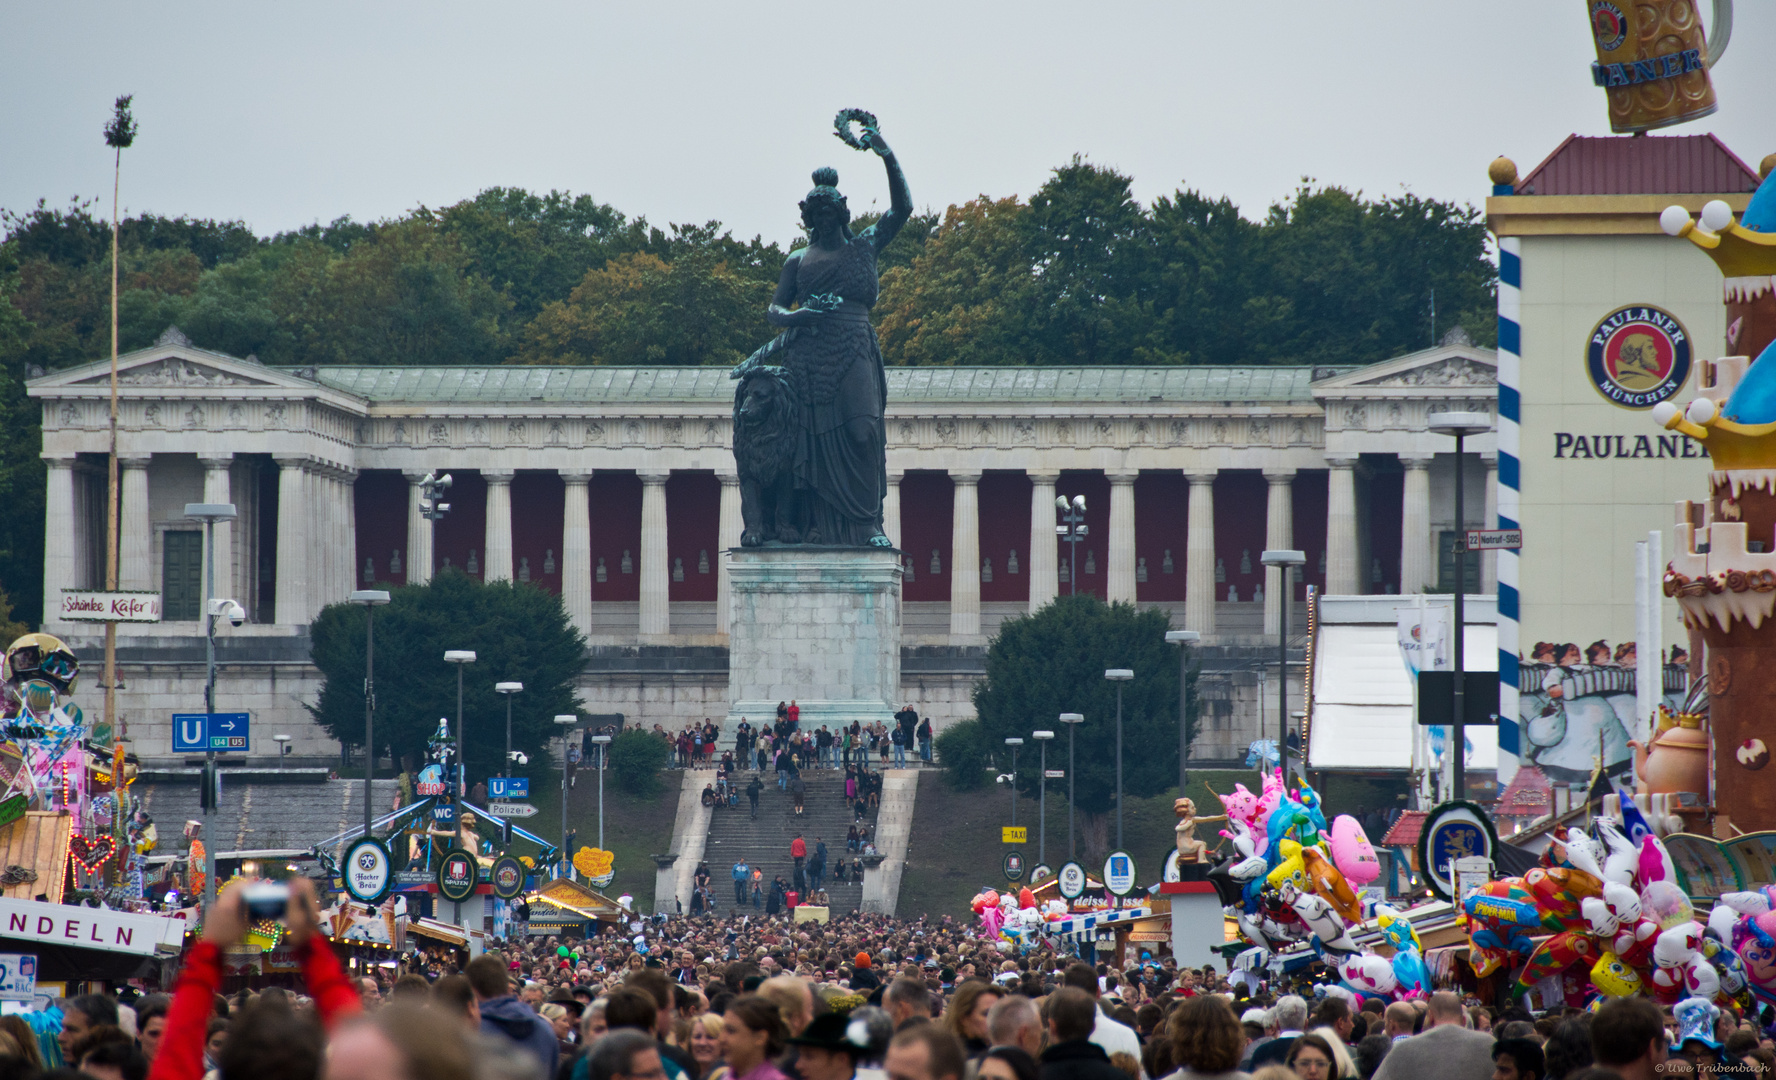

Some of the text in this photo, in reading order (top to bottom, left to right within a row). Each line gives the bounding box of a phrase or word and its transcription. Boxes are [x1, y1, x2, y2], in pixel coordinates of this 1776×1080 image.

[1592, 308, 1685, 346] PAULANER
[1600, 379, 1678, 405] MÜNCHEN
[1469, 534, 1520, 545] 22 Notruf-SOS
[111, 598, 149, 617] Käfer
[181, 720, 202, 745] U
[214, 738, 243, 746] U4 U5
[416, 783, 446, 796] SHOP
[492, 781, 504, 795] U
[433, 808, 452, 819] WC
[493, 805, 524, 815] Polizei
[1010, 830, 1026, 839] TAXI
[354, 873, 379, 881] Hacker
[358, 881, 377, 889] Bräu
[528, 908, 558, 916] andeln
[1473, 902, 1517, 922] SPIDER-MAN
[9, 912, 133, 946] NDELN
[15, 982, 31, 992] BAG
